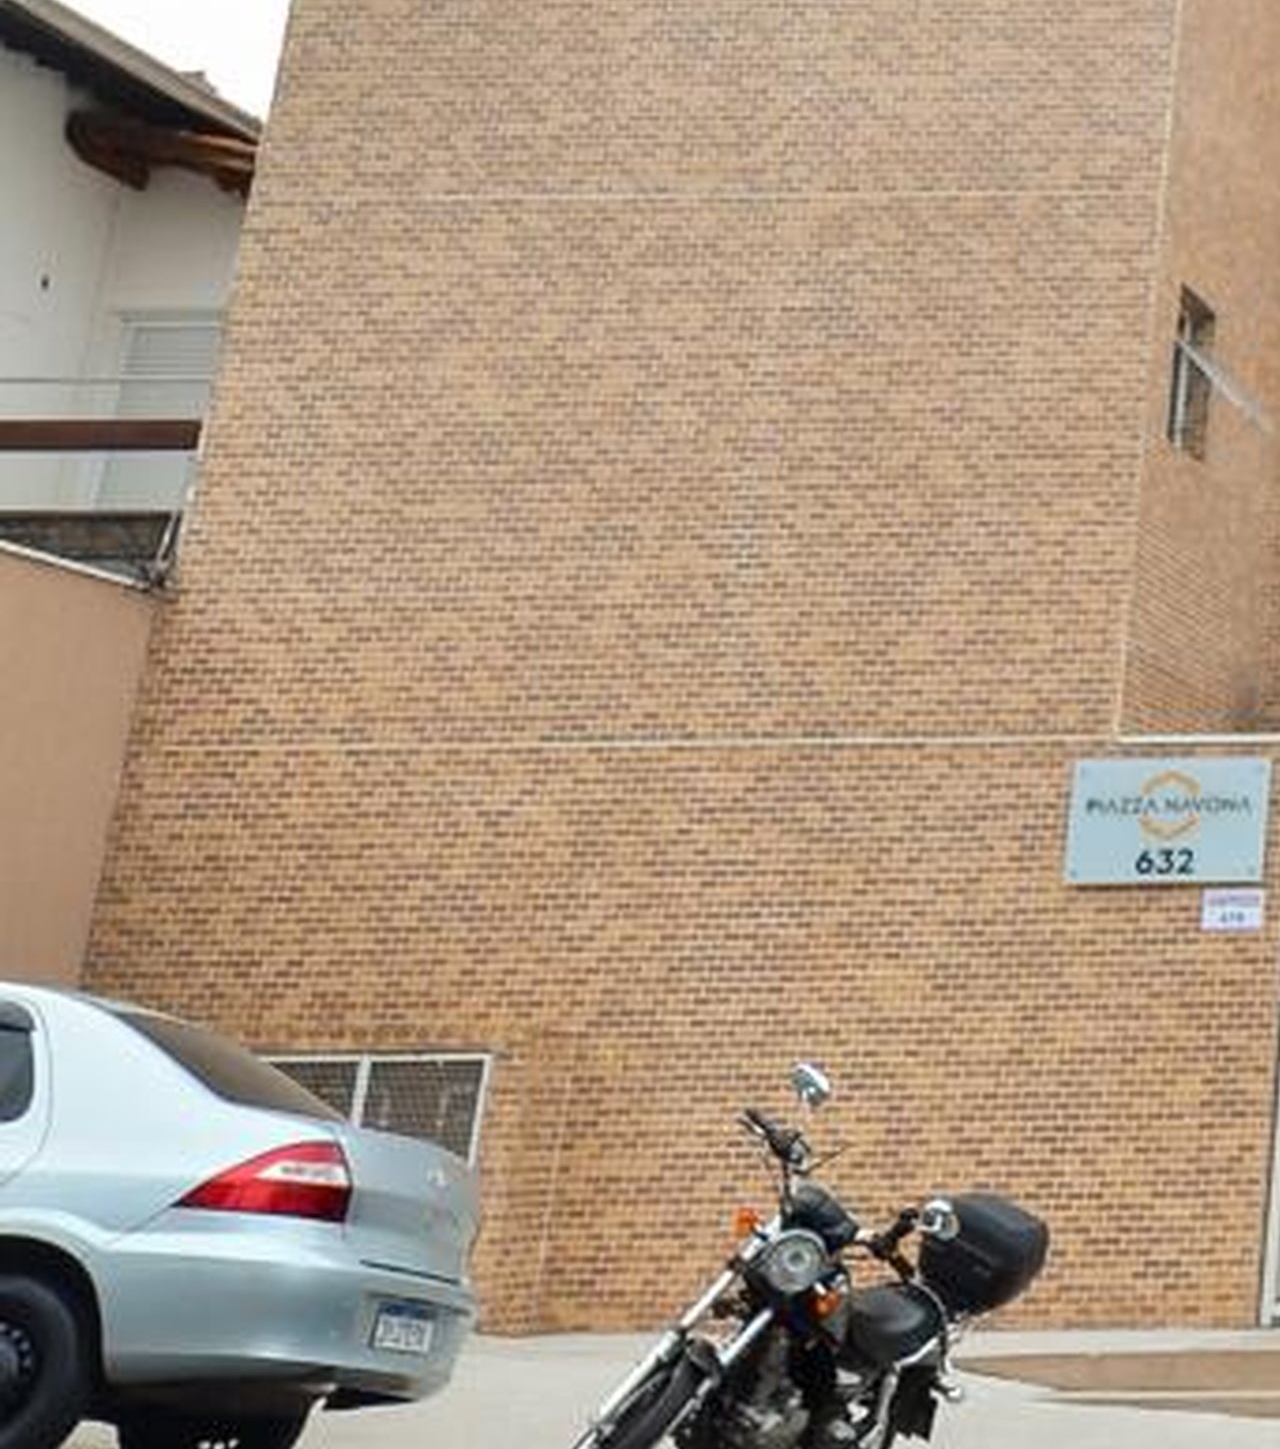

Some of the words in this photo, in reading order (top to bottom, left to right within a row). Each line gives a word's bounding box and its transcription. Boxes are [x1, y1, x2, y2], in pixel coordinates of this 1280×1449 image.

[1085, 797, 1159, 815] PIAZZA
[1163, 797, 1252, 815] NAVONA
[1135, 849, 1195, 876] 632
